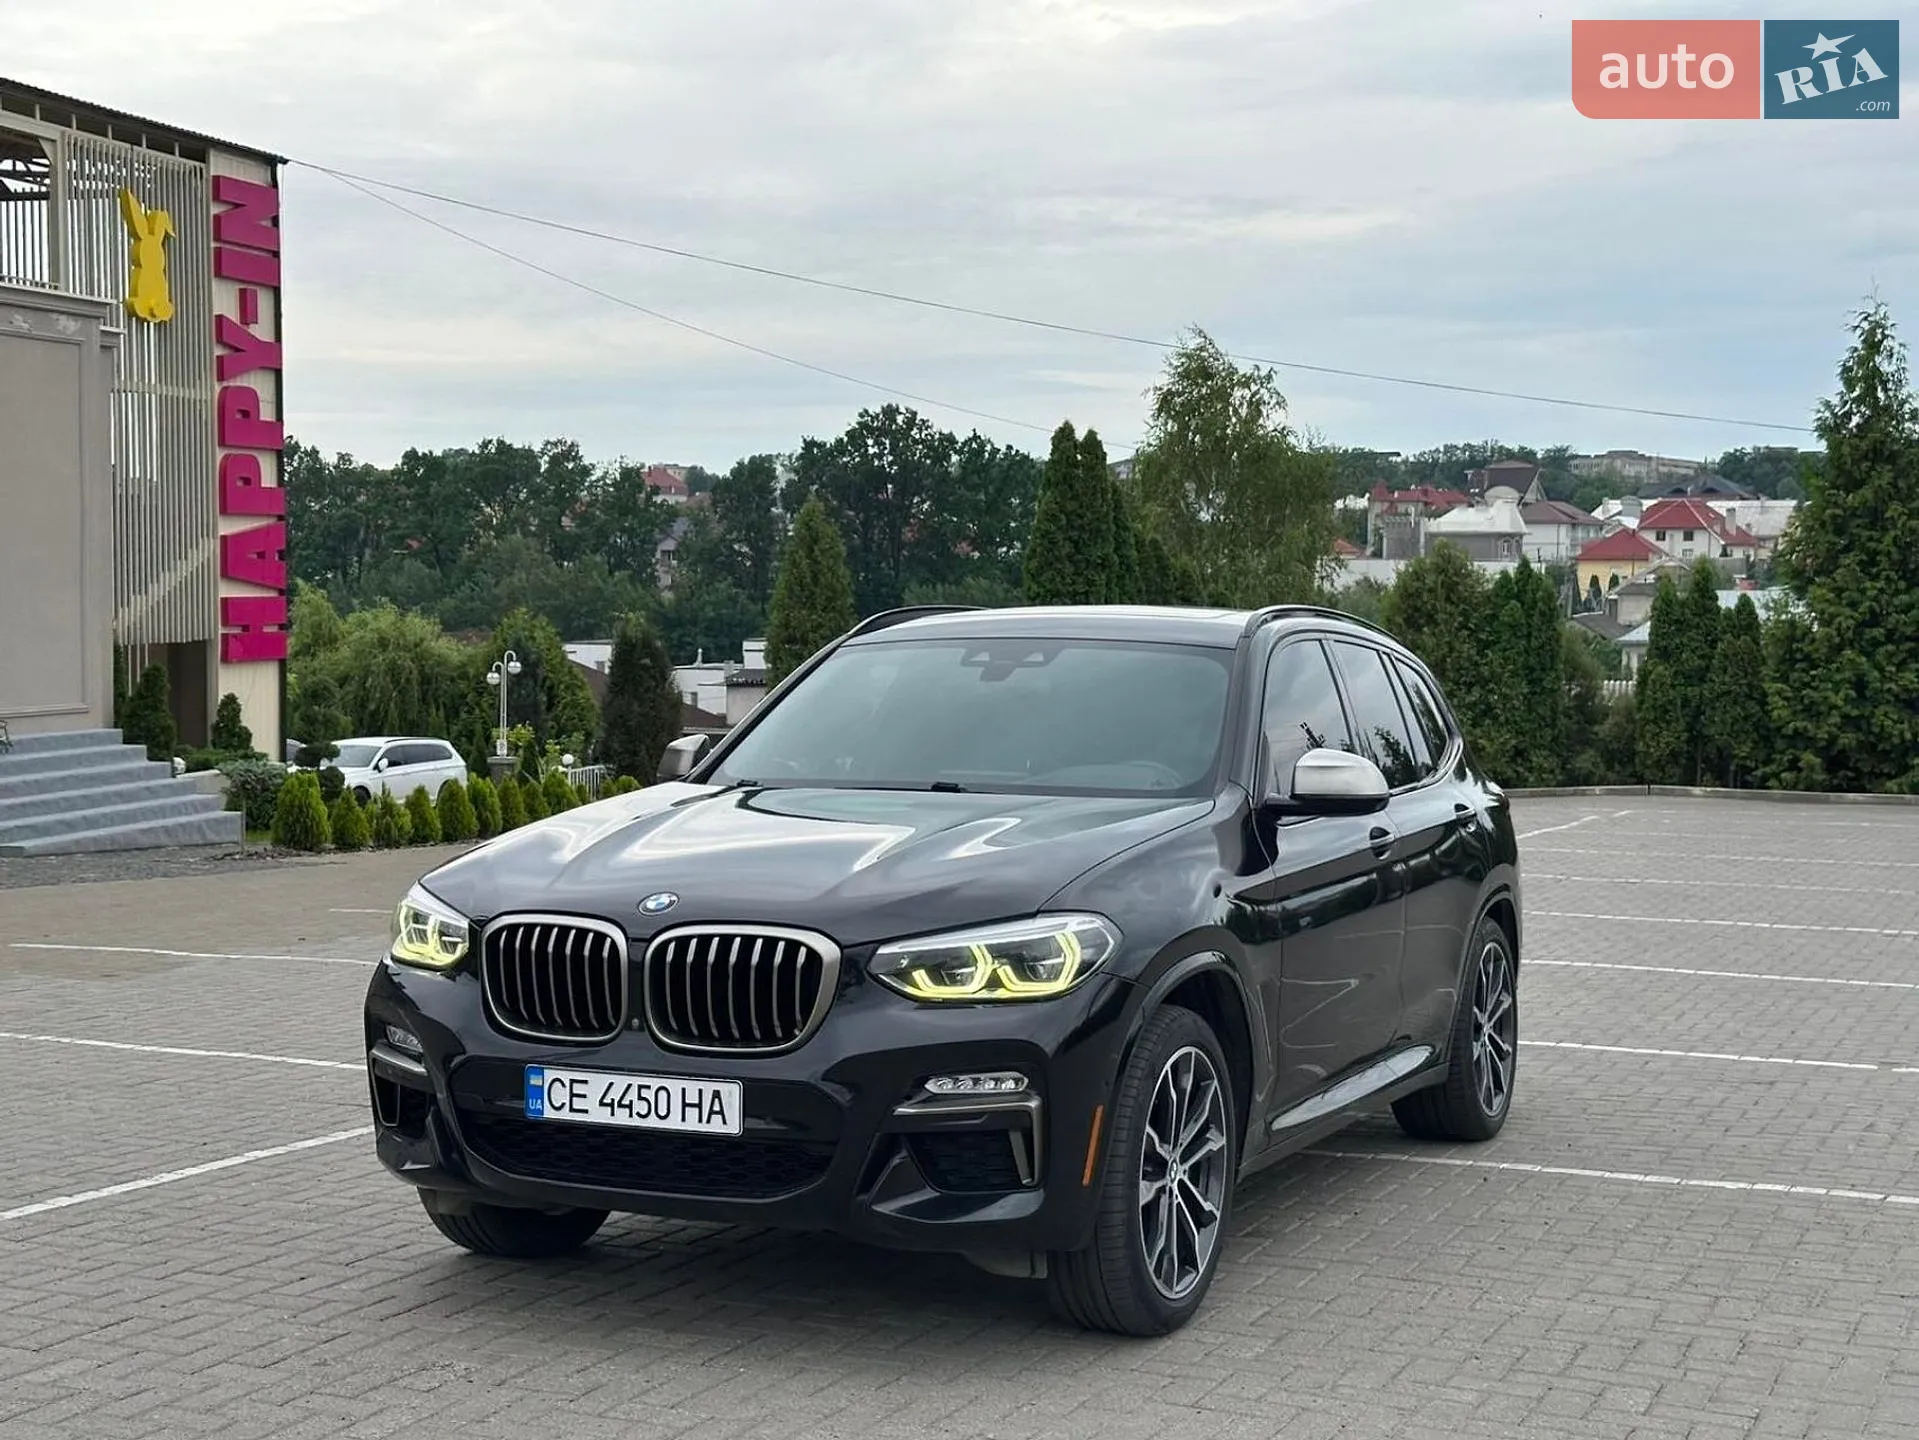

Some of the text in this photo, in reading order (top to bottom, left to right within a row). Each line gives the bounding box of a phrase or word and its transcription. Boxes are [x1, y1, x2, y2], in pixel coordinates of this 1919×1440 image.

[212, 175, 288, 663] HAPPY-IN
[529, 1099, 543, 1110] UA
[547, 1077, 727, 1125] CE 4450 HA
